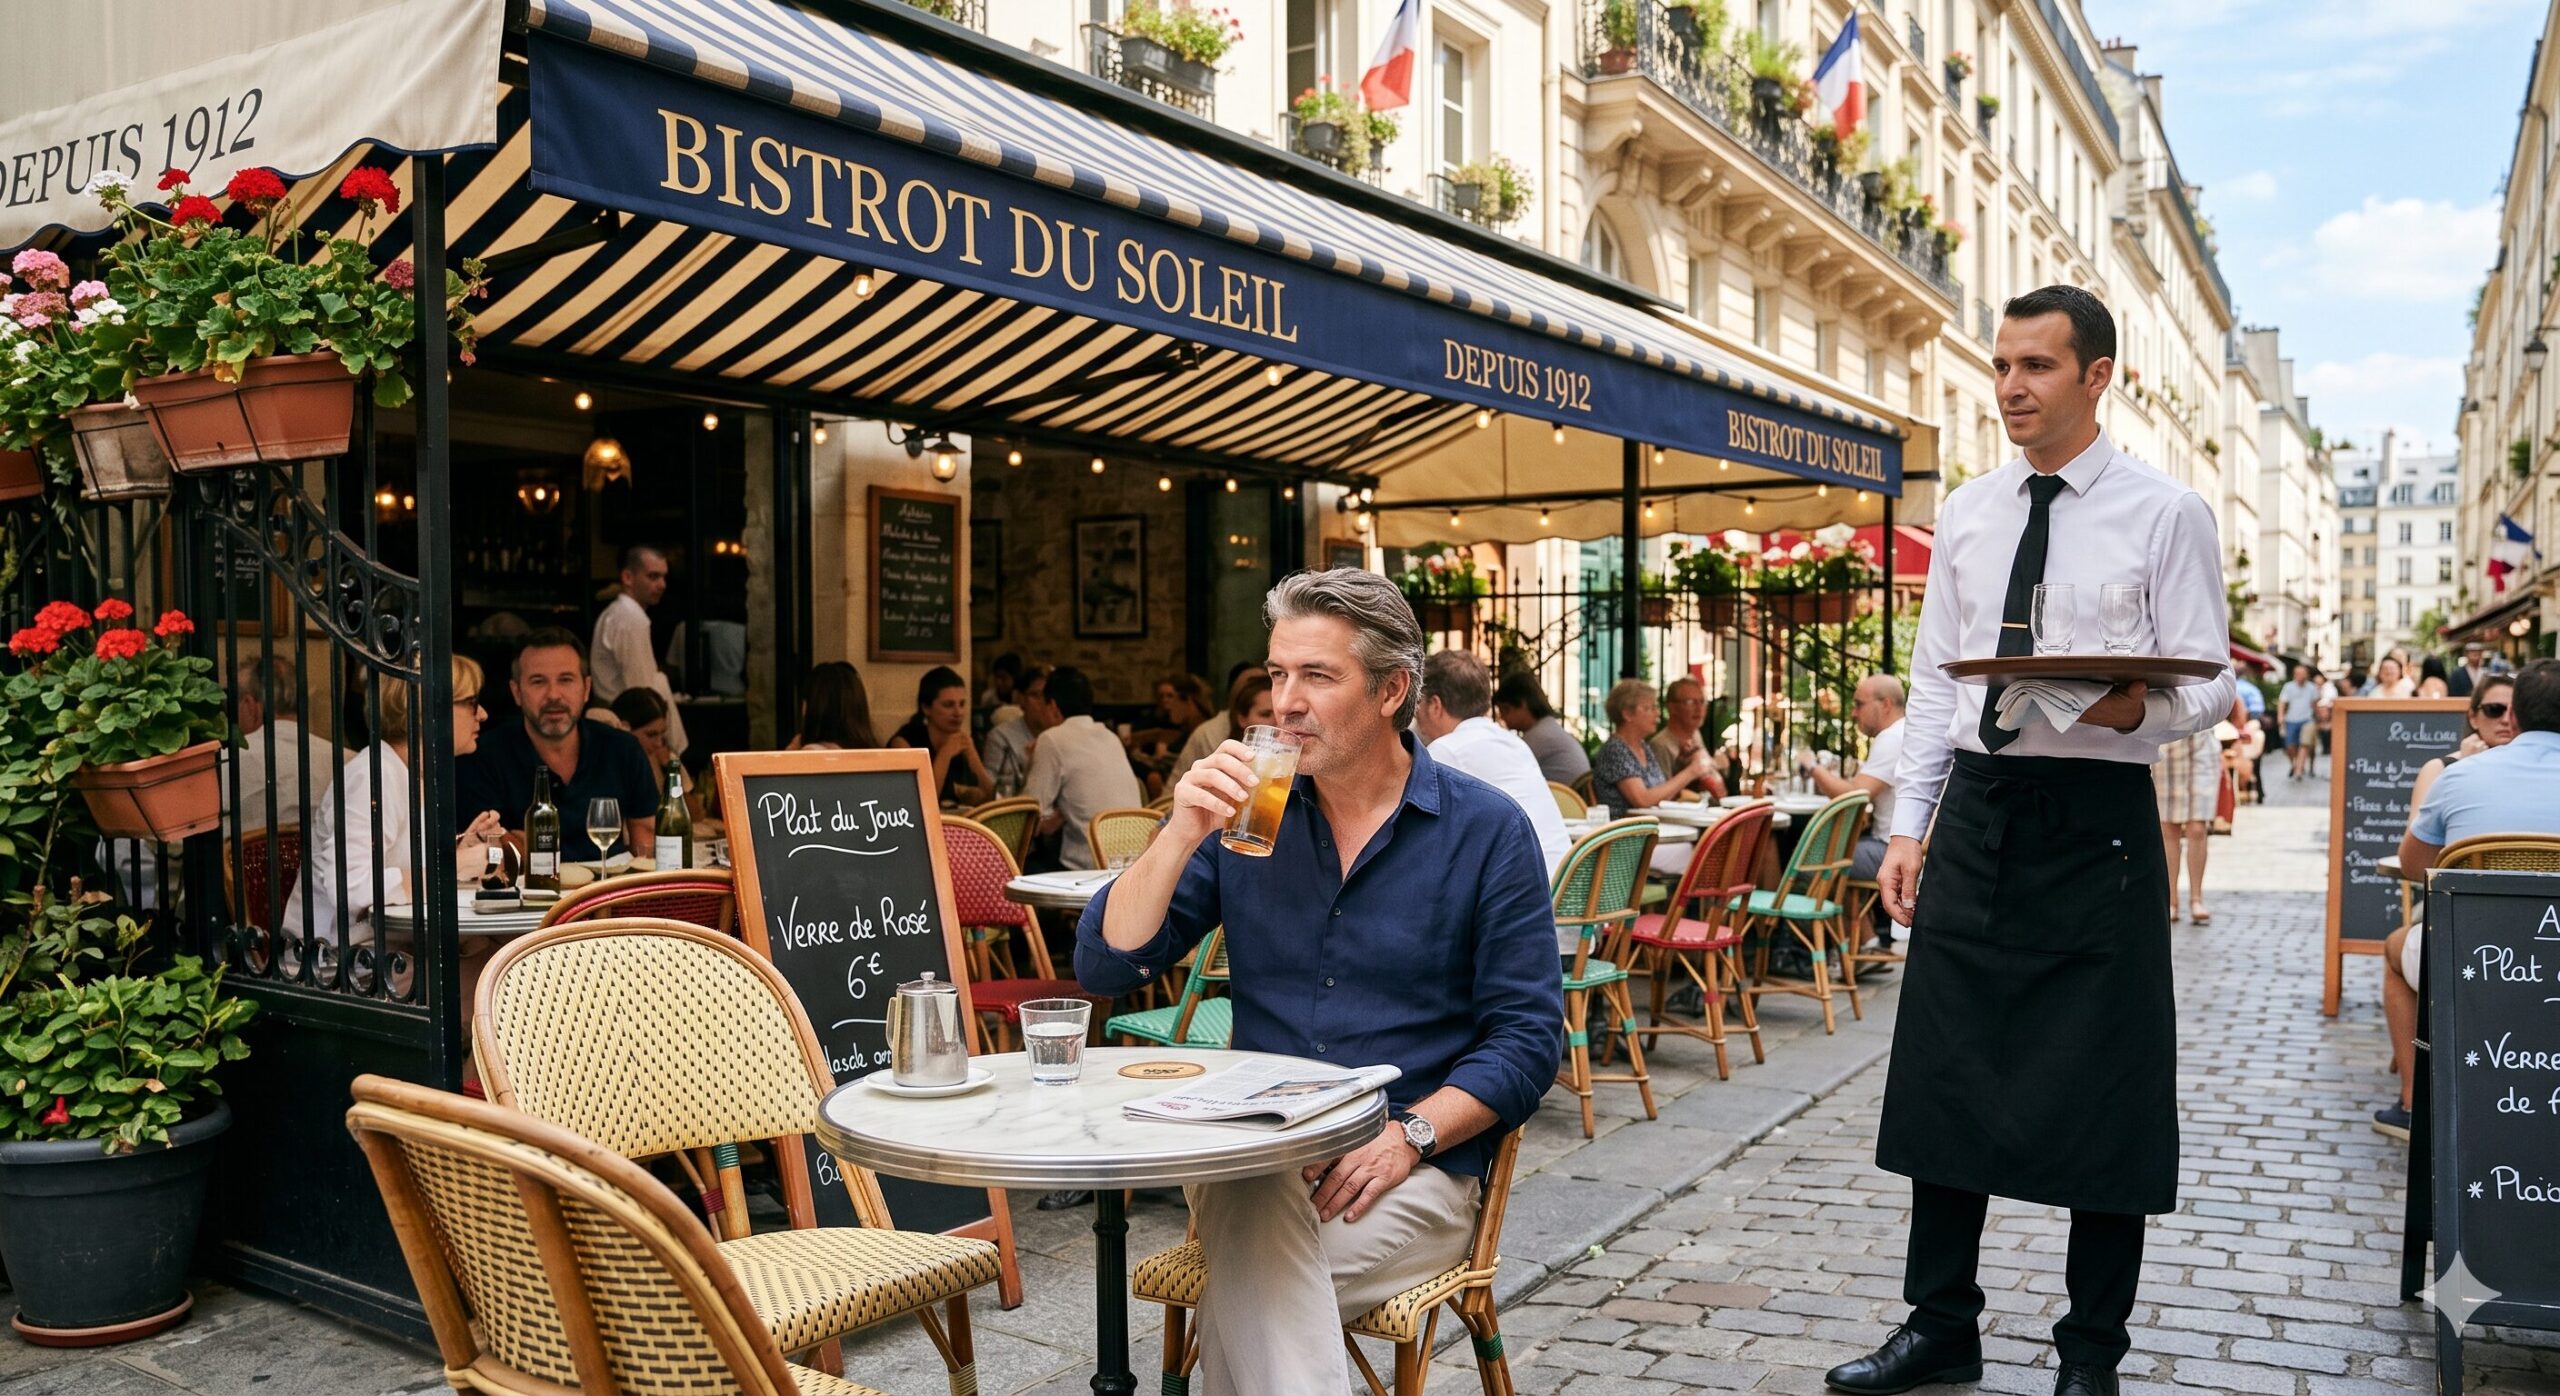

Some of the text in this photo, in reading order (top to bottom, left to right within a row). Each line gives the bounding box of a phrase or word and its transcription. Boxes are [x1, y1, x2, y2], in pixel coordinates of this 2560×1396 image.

[0, 88, 263, 208] EPUIS 1912
[657, 107, 1298, 344] BISTROT DU SOLEIL
[1443, 338, 1592, 412] DEPUIS 1912
[1727, 409, 1887, 482] BISTROT DU SOLEIL
[757, 792, 823, 838] Plat
[831, 800, 860, 832] du
[850, 905, 877, 941] de
[880, 896, 931, 937] Rosé
[847, 951, 884, 999] 6€
[2473, 944, 2543, 983] Plat
[2496, 1086, 2536, 1114] de
